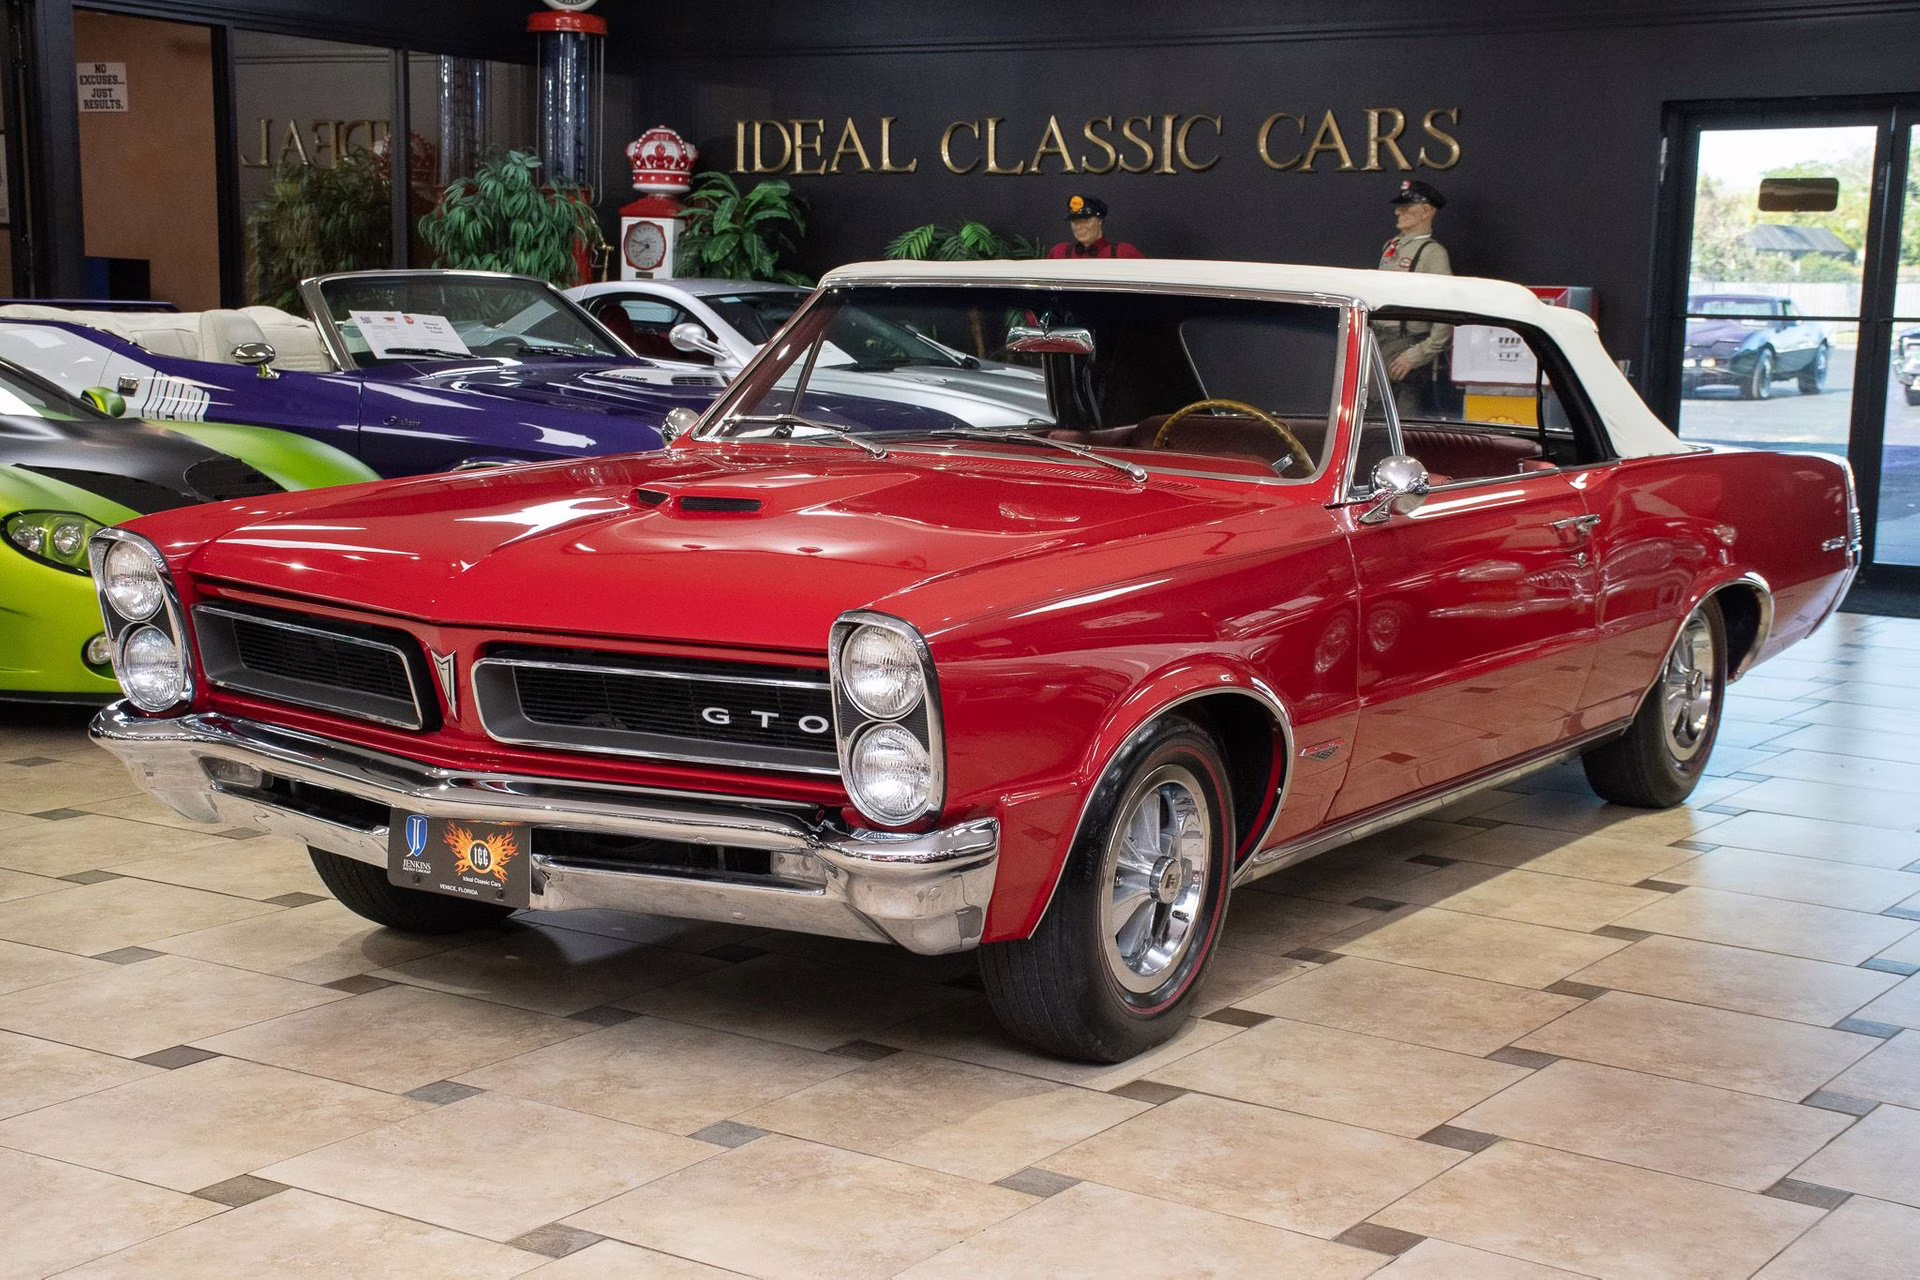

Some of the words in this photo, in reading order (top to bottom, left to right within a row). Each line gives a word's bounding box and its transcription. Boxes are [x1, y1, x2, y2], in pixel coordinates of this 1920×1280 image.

[94, 63, 107, 74] NO
[91, 88, 114, 98] JUST
[83, 99, 124, 110] RESULTS.
[730, 116, 918, 175] IDEAL
[941, 114, 1223, 175] CLASSIC
[1257, 107, 1460, 172] CARS
[701, 706, 829, 734] GTO
[402, 859, 432, 870] JENKINS
[457, 886, 479, 896] FLORIDA
